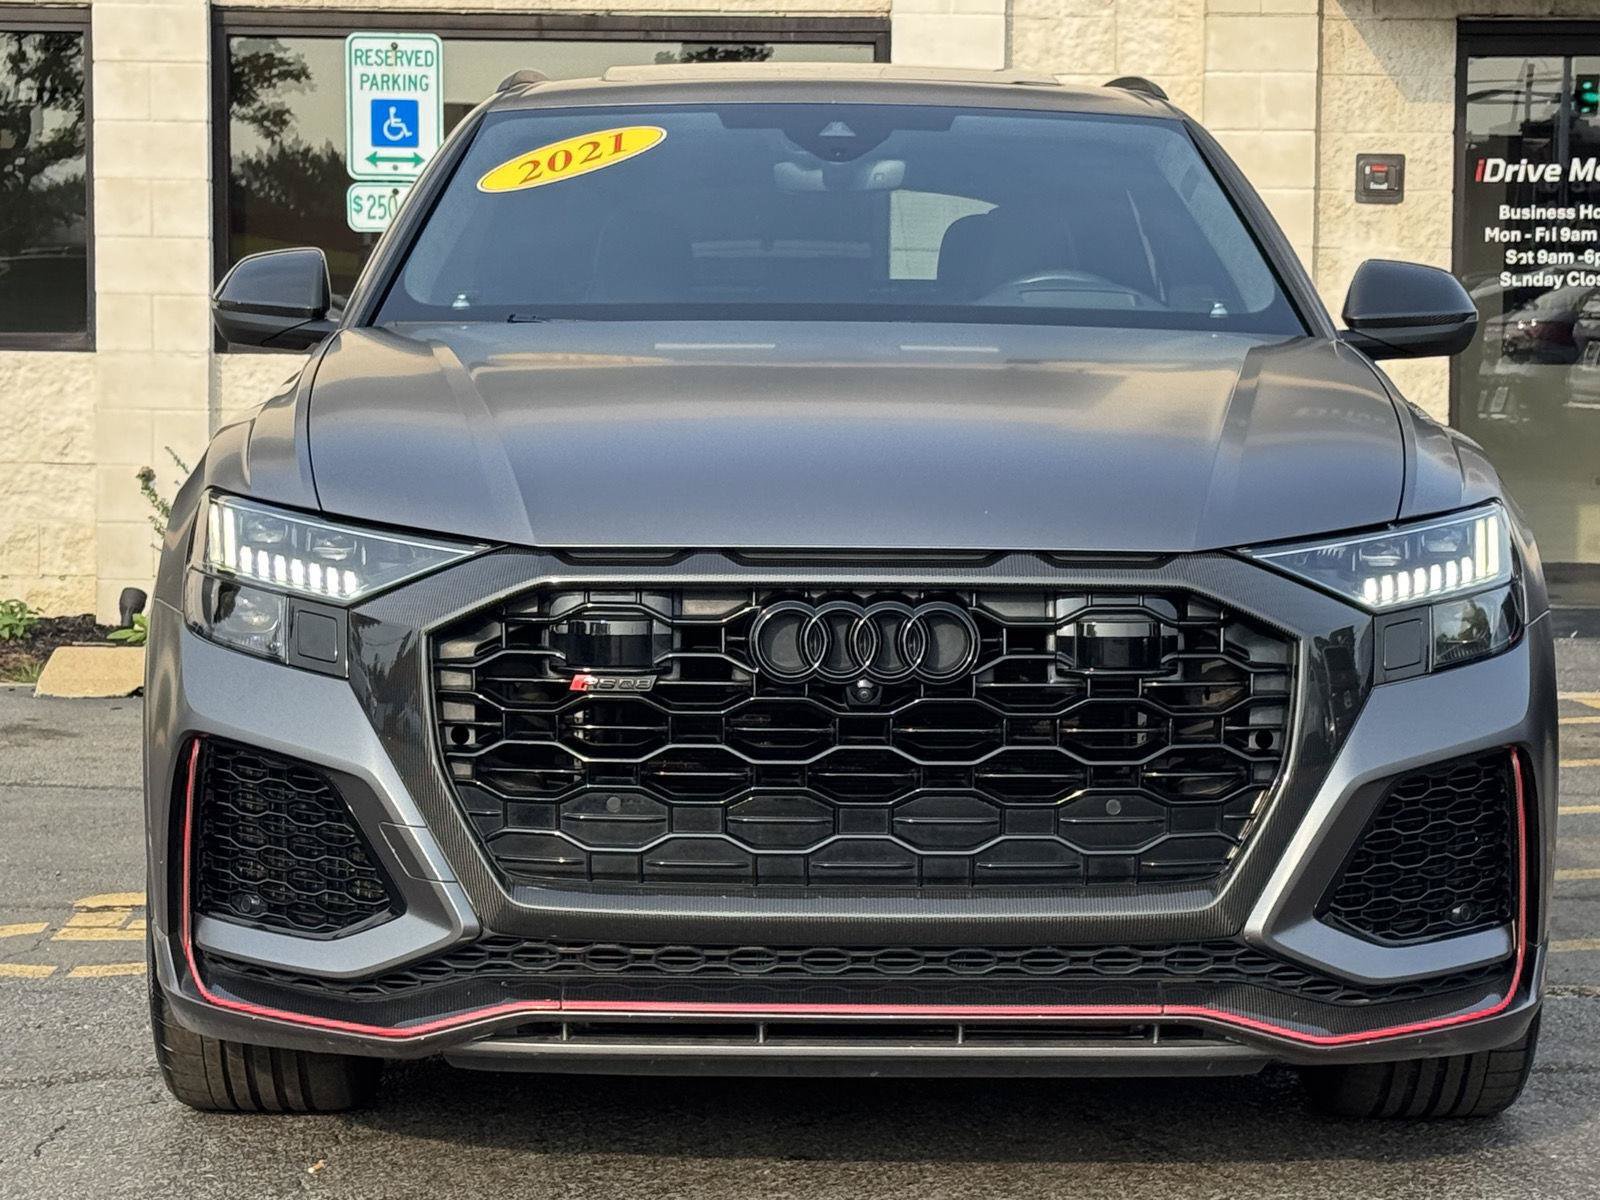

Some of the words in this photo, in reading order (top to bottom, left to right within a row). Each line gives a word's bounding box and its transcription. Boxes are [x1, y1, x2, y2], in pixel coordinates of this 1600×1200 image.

[353, 48, 434, 67] RESERVED
[359, 73, 430, 92] PARKING
[518, 132, 627, 185] 2021
[1475, 157, 1562, 183] iDrive
[1499, 204, 1576, 220] Business
[1484, 226, 1522, 243] Mon
[1559, 226, 1598, 243] 9am
[1536, 248, 1575, 265] 9am
[1499, 270, 1565, 291] Sunday
